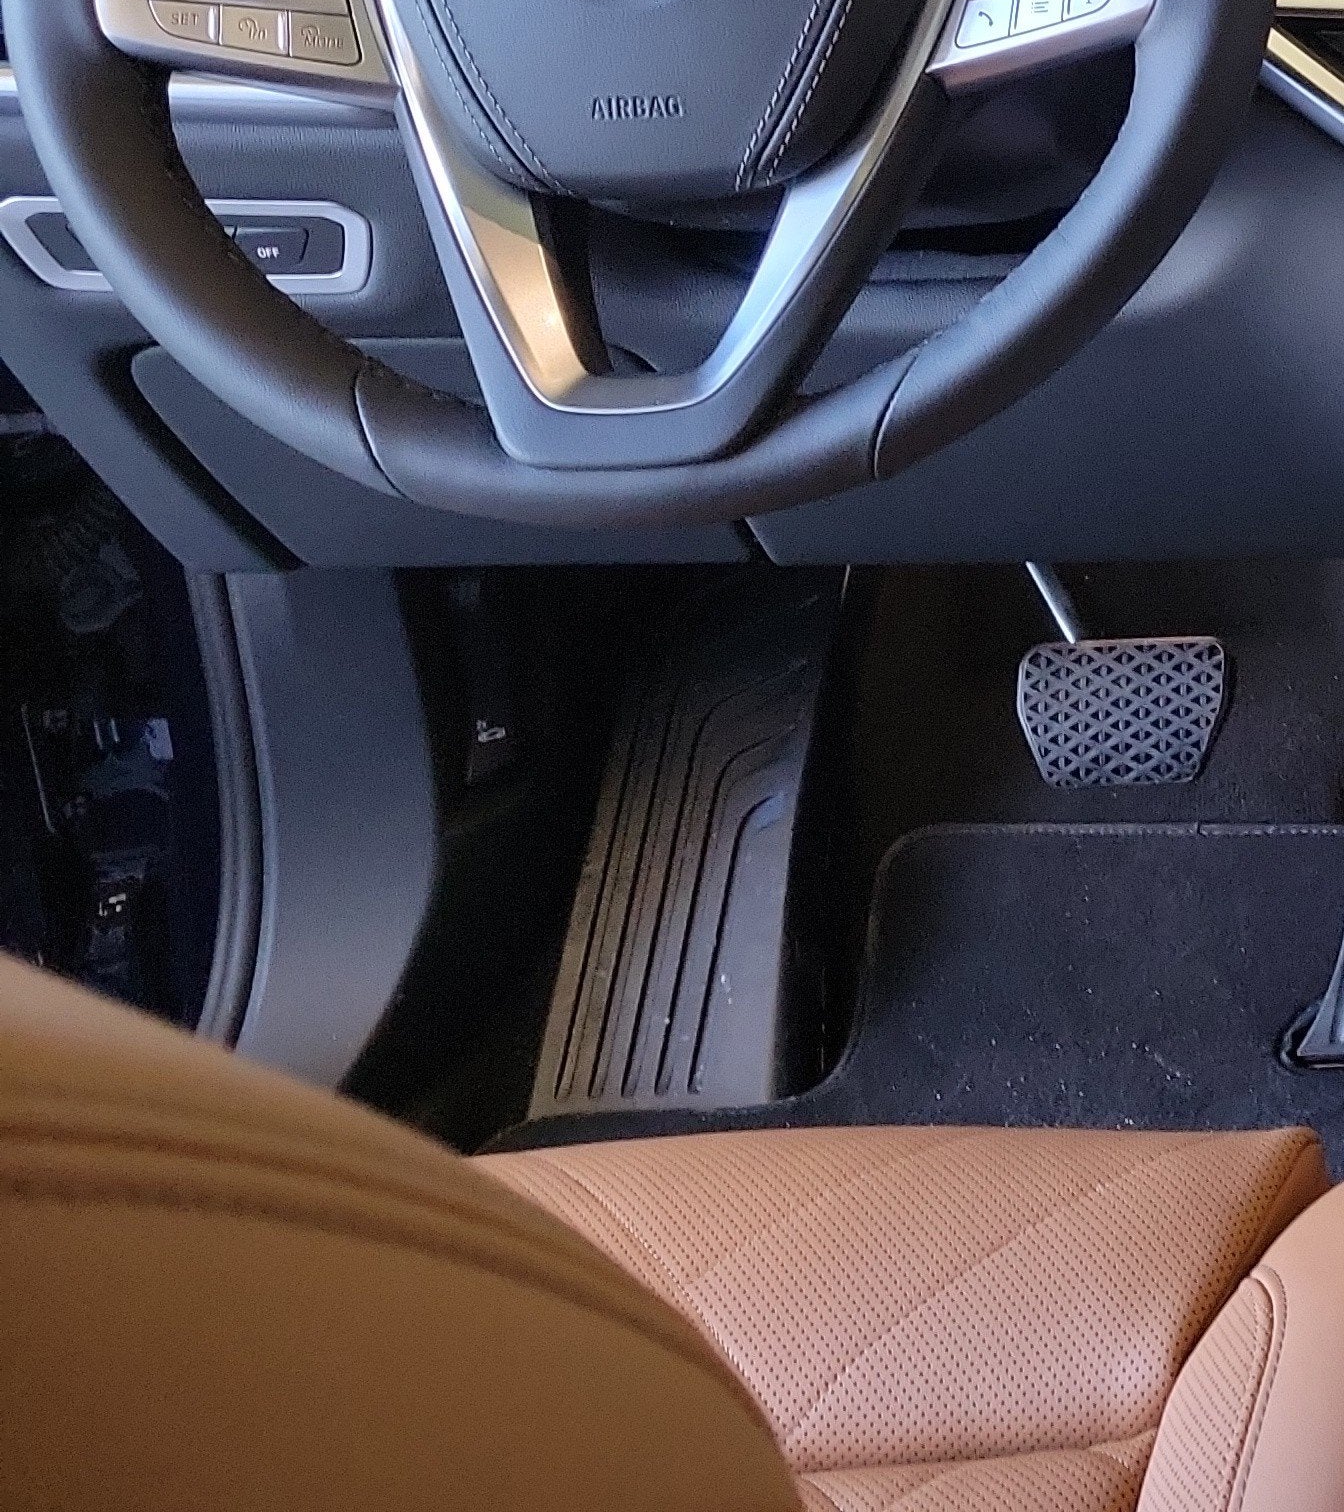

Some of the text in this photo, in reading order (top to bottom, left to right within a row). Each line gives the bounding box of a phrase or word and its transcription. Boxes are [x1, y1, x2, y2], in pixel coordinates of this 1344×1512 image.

[170, 12, 200, 27] SET
[591, 95, 685, 121] AIRBAG
[256, 246, 280, 259] OFF
